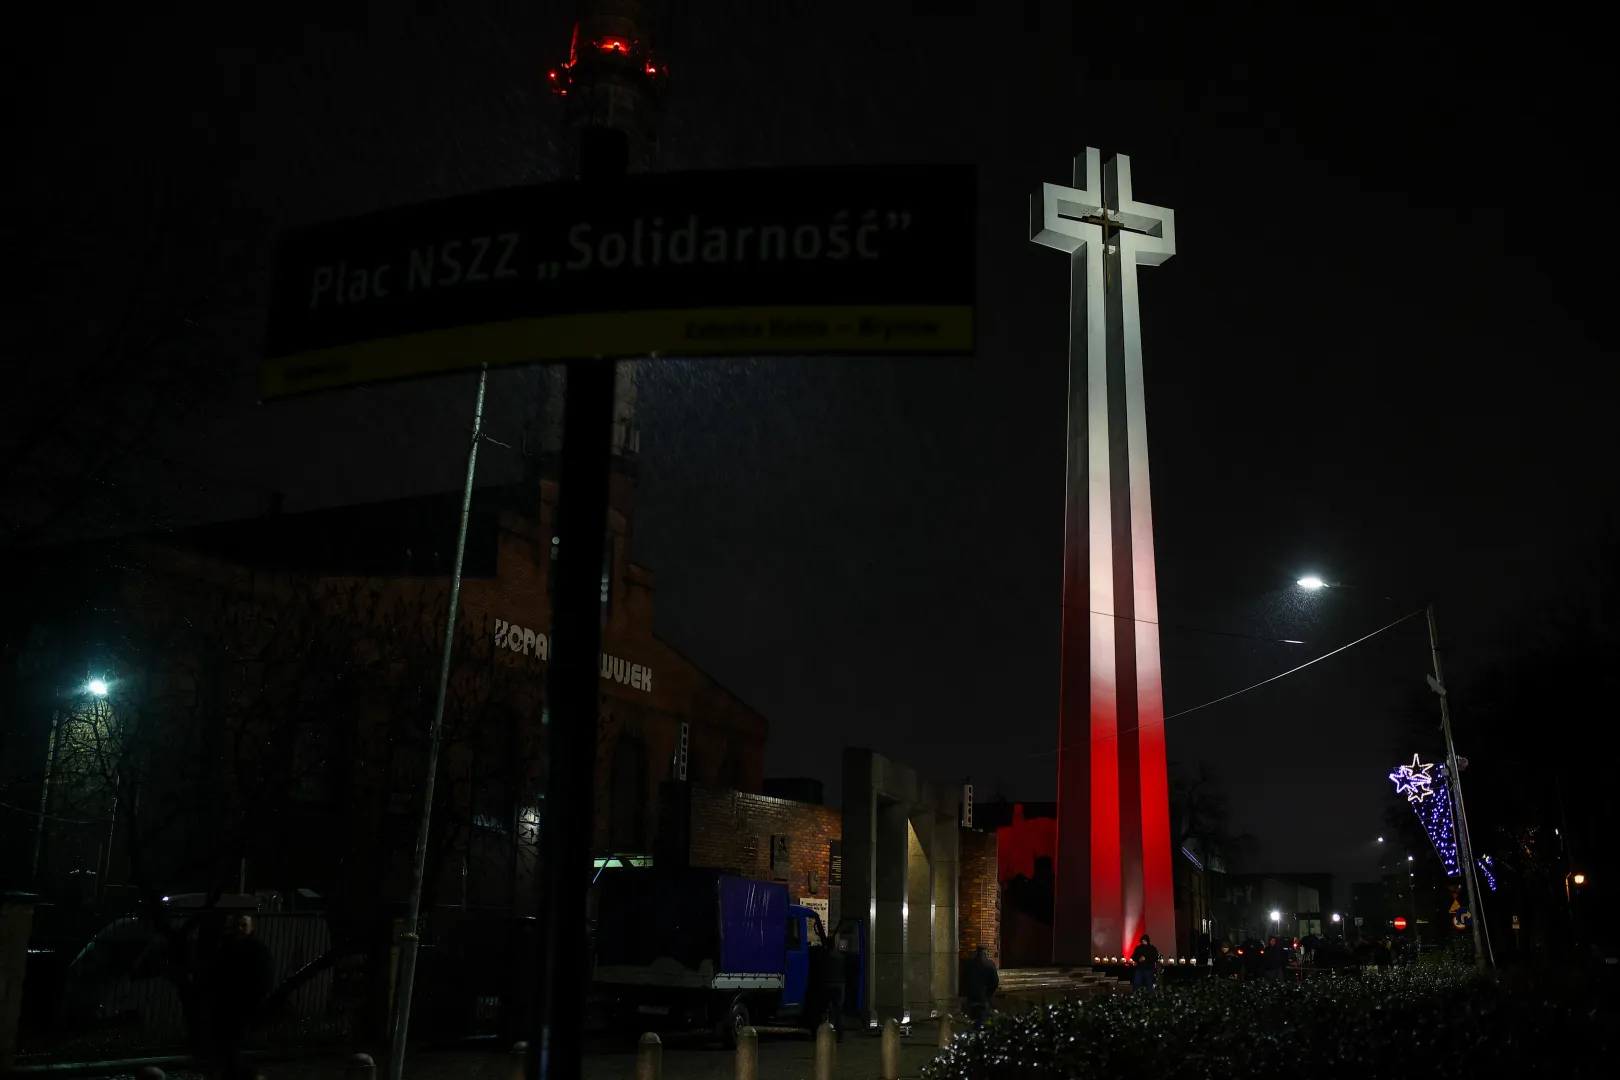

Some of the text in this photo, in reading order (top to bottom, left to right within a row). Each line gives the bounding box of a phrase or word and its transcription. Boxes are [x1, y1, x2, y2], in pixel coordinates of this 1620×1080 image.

[309, 260, 391, 309] Plac
[407, 231, 520, 291] NSZZ
[494, 618, 652, 693] KOPA WUJEK
